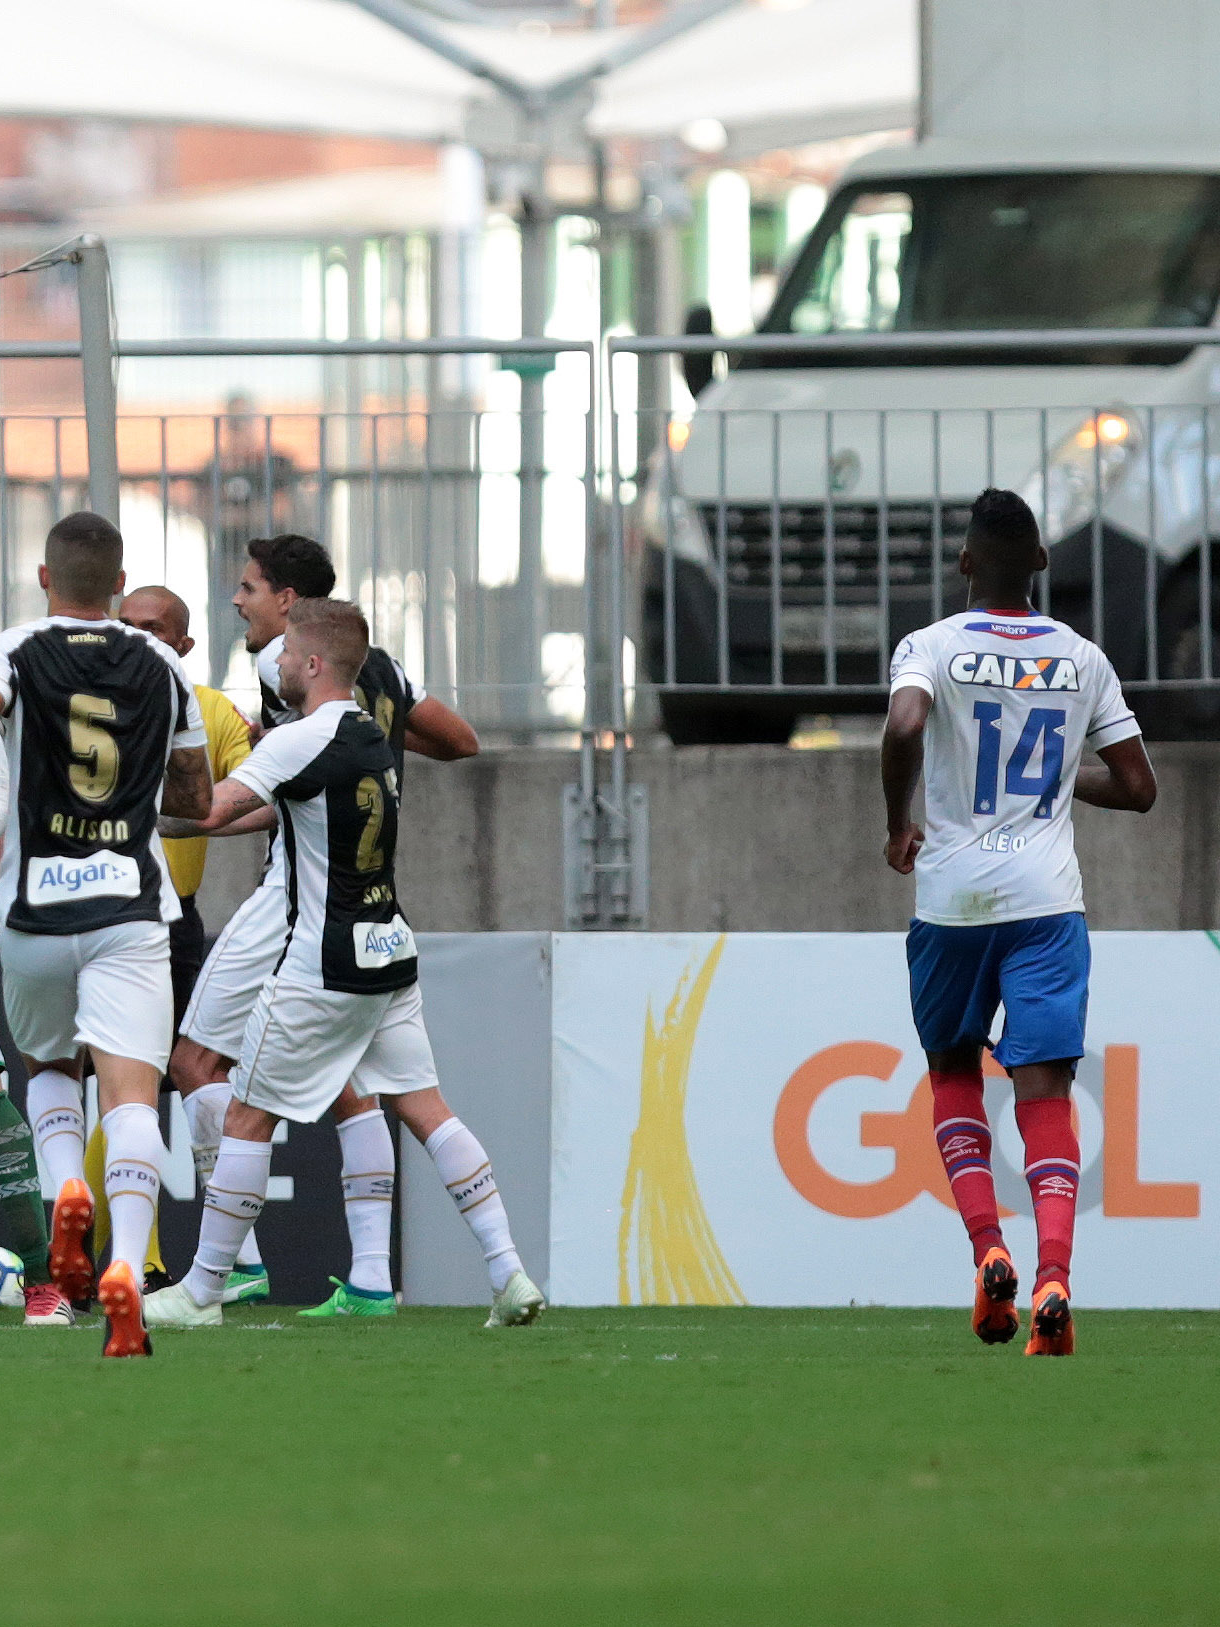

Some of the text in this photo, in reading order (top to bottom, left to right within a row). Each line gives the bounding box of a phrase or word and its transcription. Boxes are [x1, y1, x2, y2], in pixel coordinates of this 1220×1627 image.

[67, 633, 107, 644] umbro
[991, 622, 1028, 635] umbro
[949, 652, 1080, 692] CAIXA
[69, 693, 120, 803] 5
[972, 700, 1067, 819] 14
[50, 812, 130, 843] ALISON
[38, 861, 107, 892] Algar
[772, 1039, 1200, 1219] GOL
